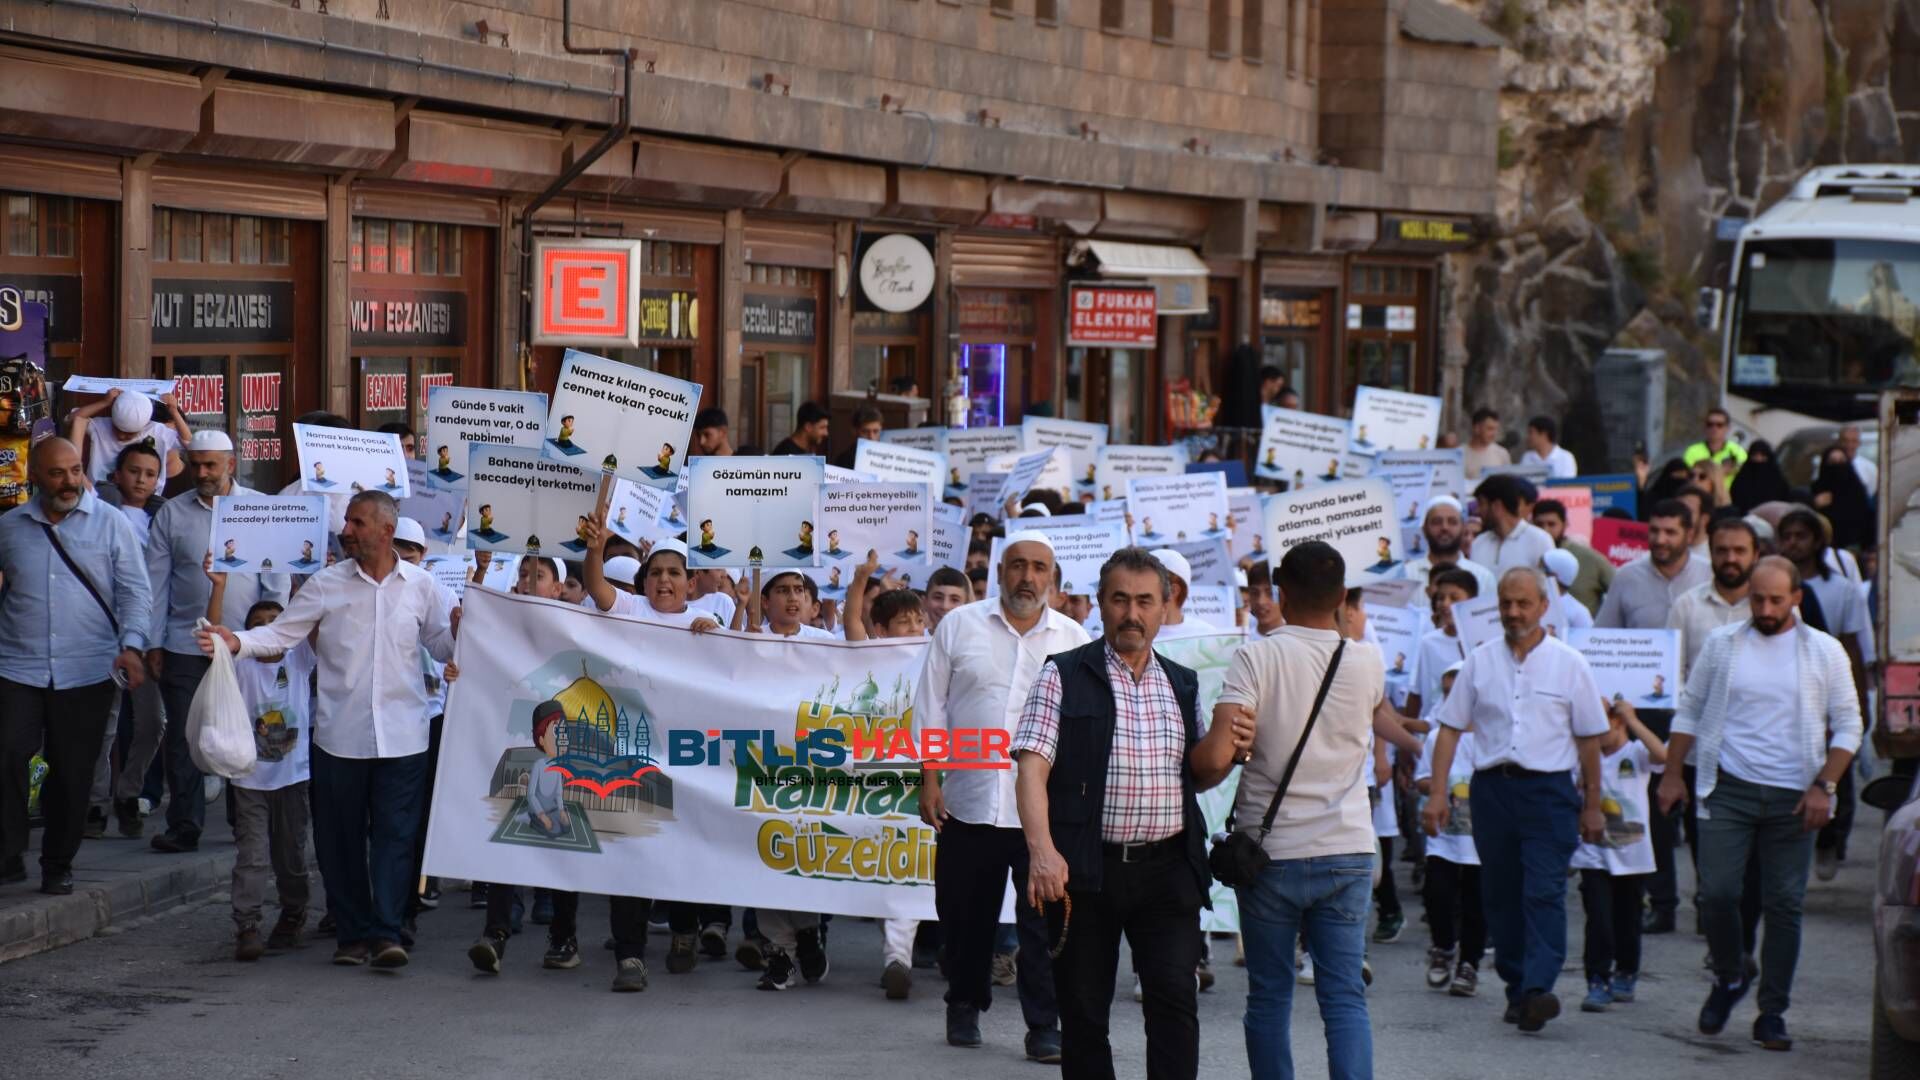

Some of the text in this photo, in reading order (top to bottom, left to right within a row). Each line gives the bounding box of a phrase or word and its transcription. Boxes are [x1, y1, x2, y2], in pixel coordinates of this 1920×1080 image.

[1097, 292, 1154, 309] FURKAN
[1075, 310, 1152, 328] ELEKTRİK
[241, 373, 281, 412] UMUT
[366, 373, 407, 411] ECZANE
[570, 364, 689, 407] Namaz kılan çocuk,
[451, 399, 525, 414] Günde 5 vakit
[562, 381, 689, 423] cennet kokan çocuk!
[435, 415, 540, 431] randevum var, O da
[306, 431, 337, 440] Namaz
[459, 431, 515, 444] Rabbimle!
[241, 438, 281, 461] 226 75 75
[337, 444, 364, 452] kokan
[488, 456, 583, 477] Bahane üretme,
[712, 469, 802, 480] Gözümün nuru
[474, 472, 596, 493] seccadeyi terketme!
[726, 486, 788, 496] namazım!
[827, 490, 918, 501] Wi-Fi çekmeyebilir
[233, 503, 309, 513] Bahane üretme,
[848, 503, 868, 512] dua
[869, 503, 885, 511] her
[887, 503, 921, 513] yerden
[1289, 489, 1367, 515] Oyunda level
[222, 515, 319, 525] seccadeyi terketme!
[856, 516, 888, 527] ulaşır!
[1278, 504, 1383, 533] atlama, namazda
[1065, 532, 1110, 542] soğuğuna
[1335, 519, 1383, 540] yükselt!
[1589, 636, 1628, 646] Oyunda
